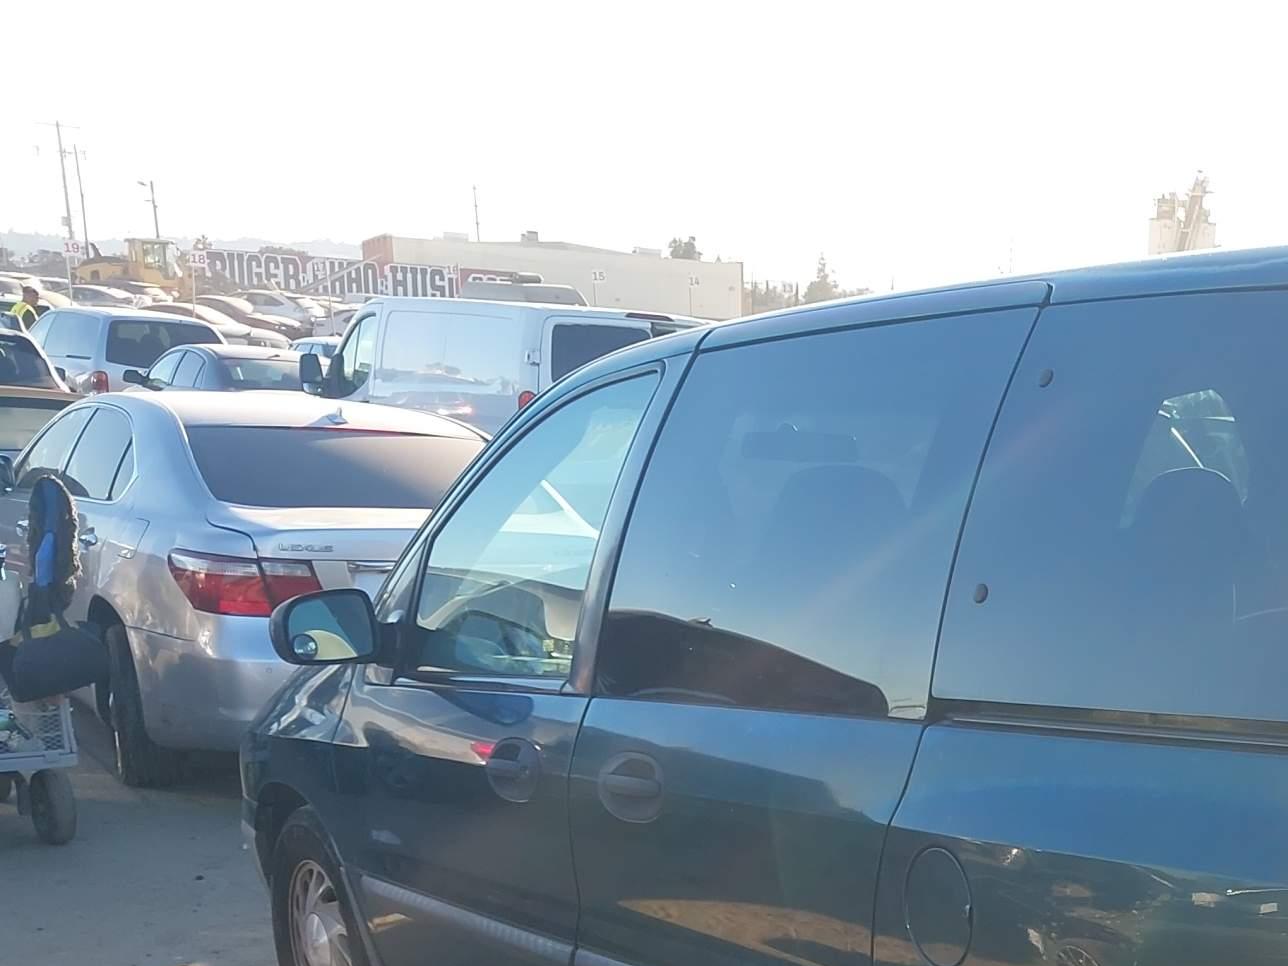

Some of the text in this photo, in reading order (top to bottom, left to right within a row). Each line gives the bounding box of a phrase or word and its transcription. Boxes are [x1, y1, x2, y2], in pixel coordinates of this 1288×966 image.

[63, 242, 80, 254] 19
[191, 254, 205, 264] 18
[592, 271, 605, 281] 15
